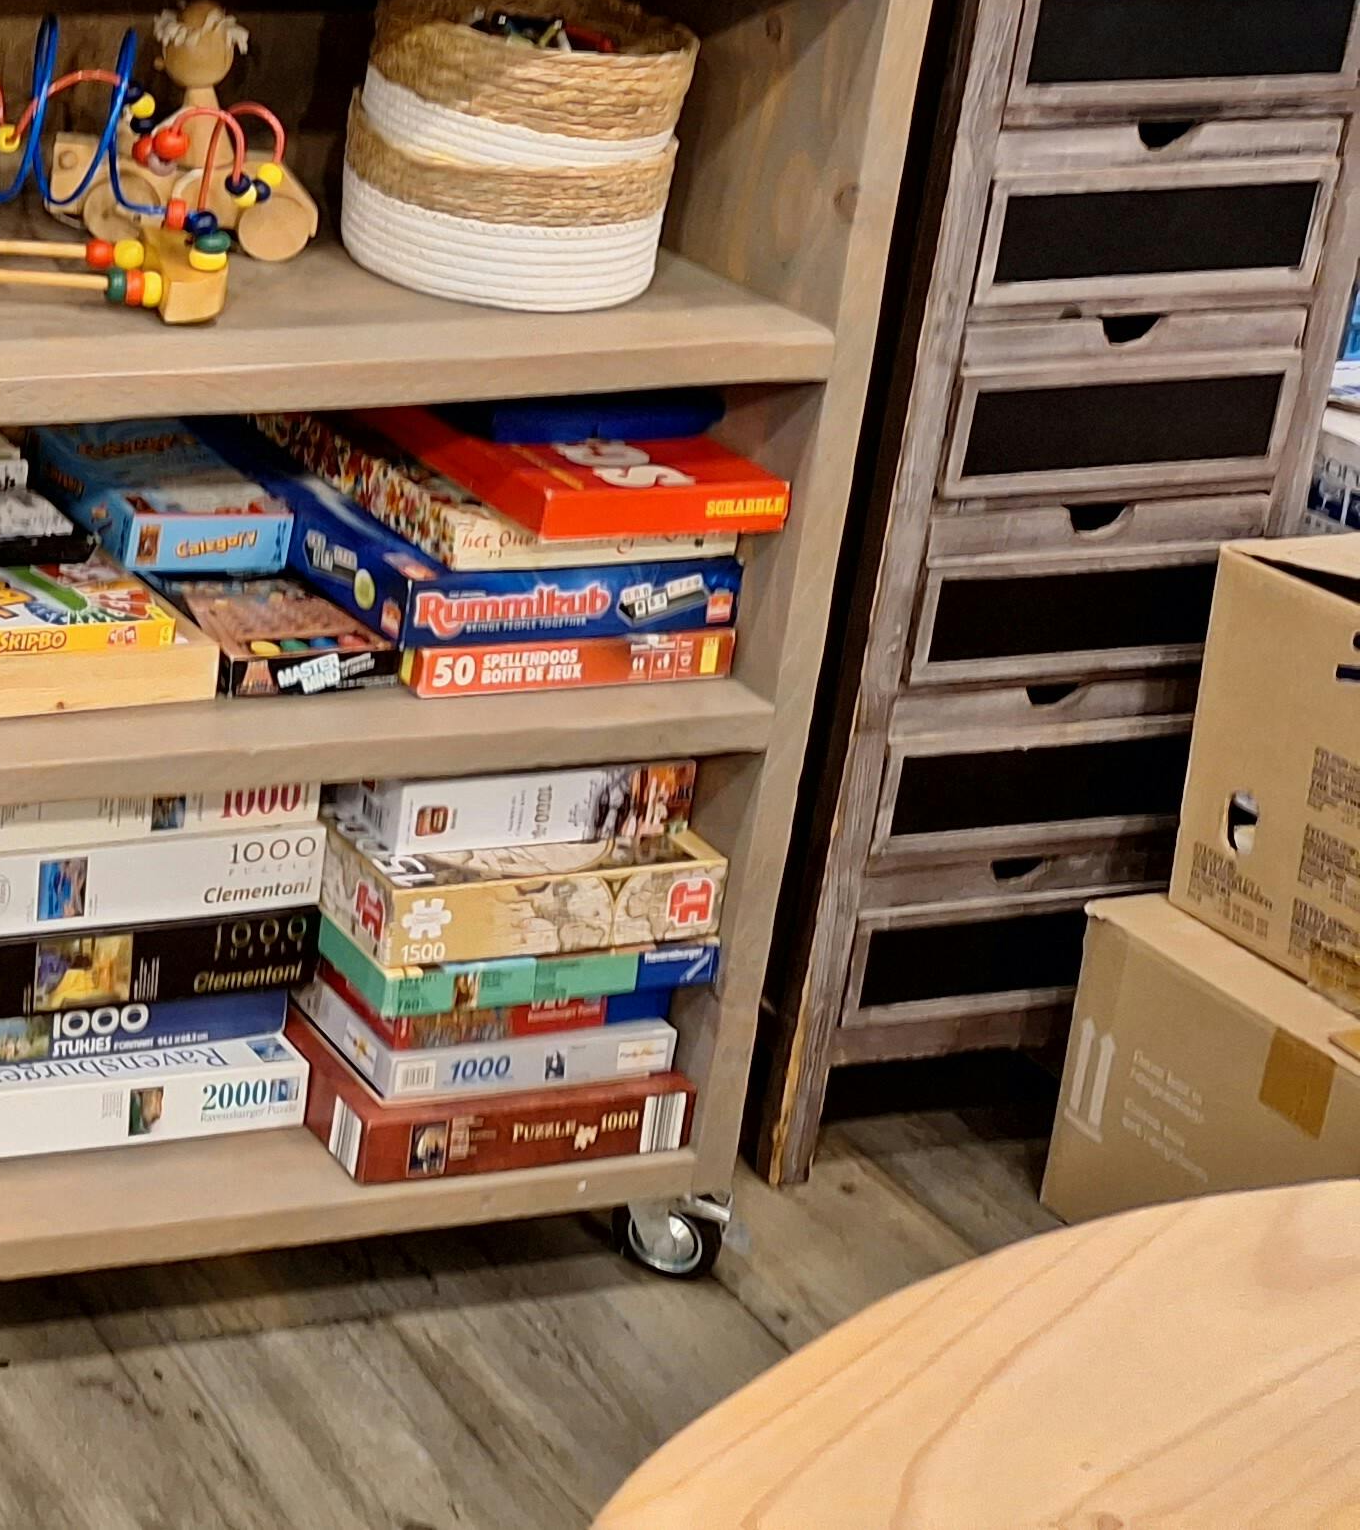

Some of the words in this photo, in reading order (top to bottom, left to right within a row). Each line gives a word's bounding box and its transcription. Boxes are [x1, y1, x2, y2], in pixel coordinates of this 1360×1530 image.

[705, 495, 785, 518] SCRABBLE
[175, 531, 258, 559] Category
[414, 584, 611, 639] Rummikub
[277, 653, 340, 688] MASTER
[302, 670, 340, 694] MIND
[432, 655, 477, 687] 50
[481, 649, 579, 668] SPELLENDOOS
[481, 665, 521, 684] BOITE
[524, 665, 544, 682] DE
[546, 662, 582, 681] JEUX
[222, 783, 301, 819] 1000
[229, 837, 317, 865] 1000
[203, 877, 312, 905] Clementoni
[400, 942, 446, 963] 1500
[193, 960, 303, 993] Clementoni
[52, 1003, 150, 1039] 1000
[52, 1035, 112, 1058] STUKJES
[451, 1055, 511, 1082] 1000
[201, 1078, 268, 1112] 2000
[512, 1121, 576, 1143] PUZZLE
[601, 1110, 639, 1132] 1000
